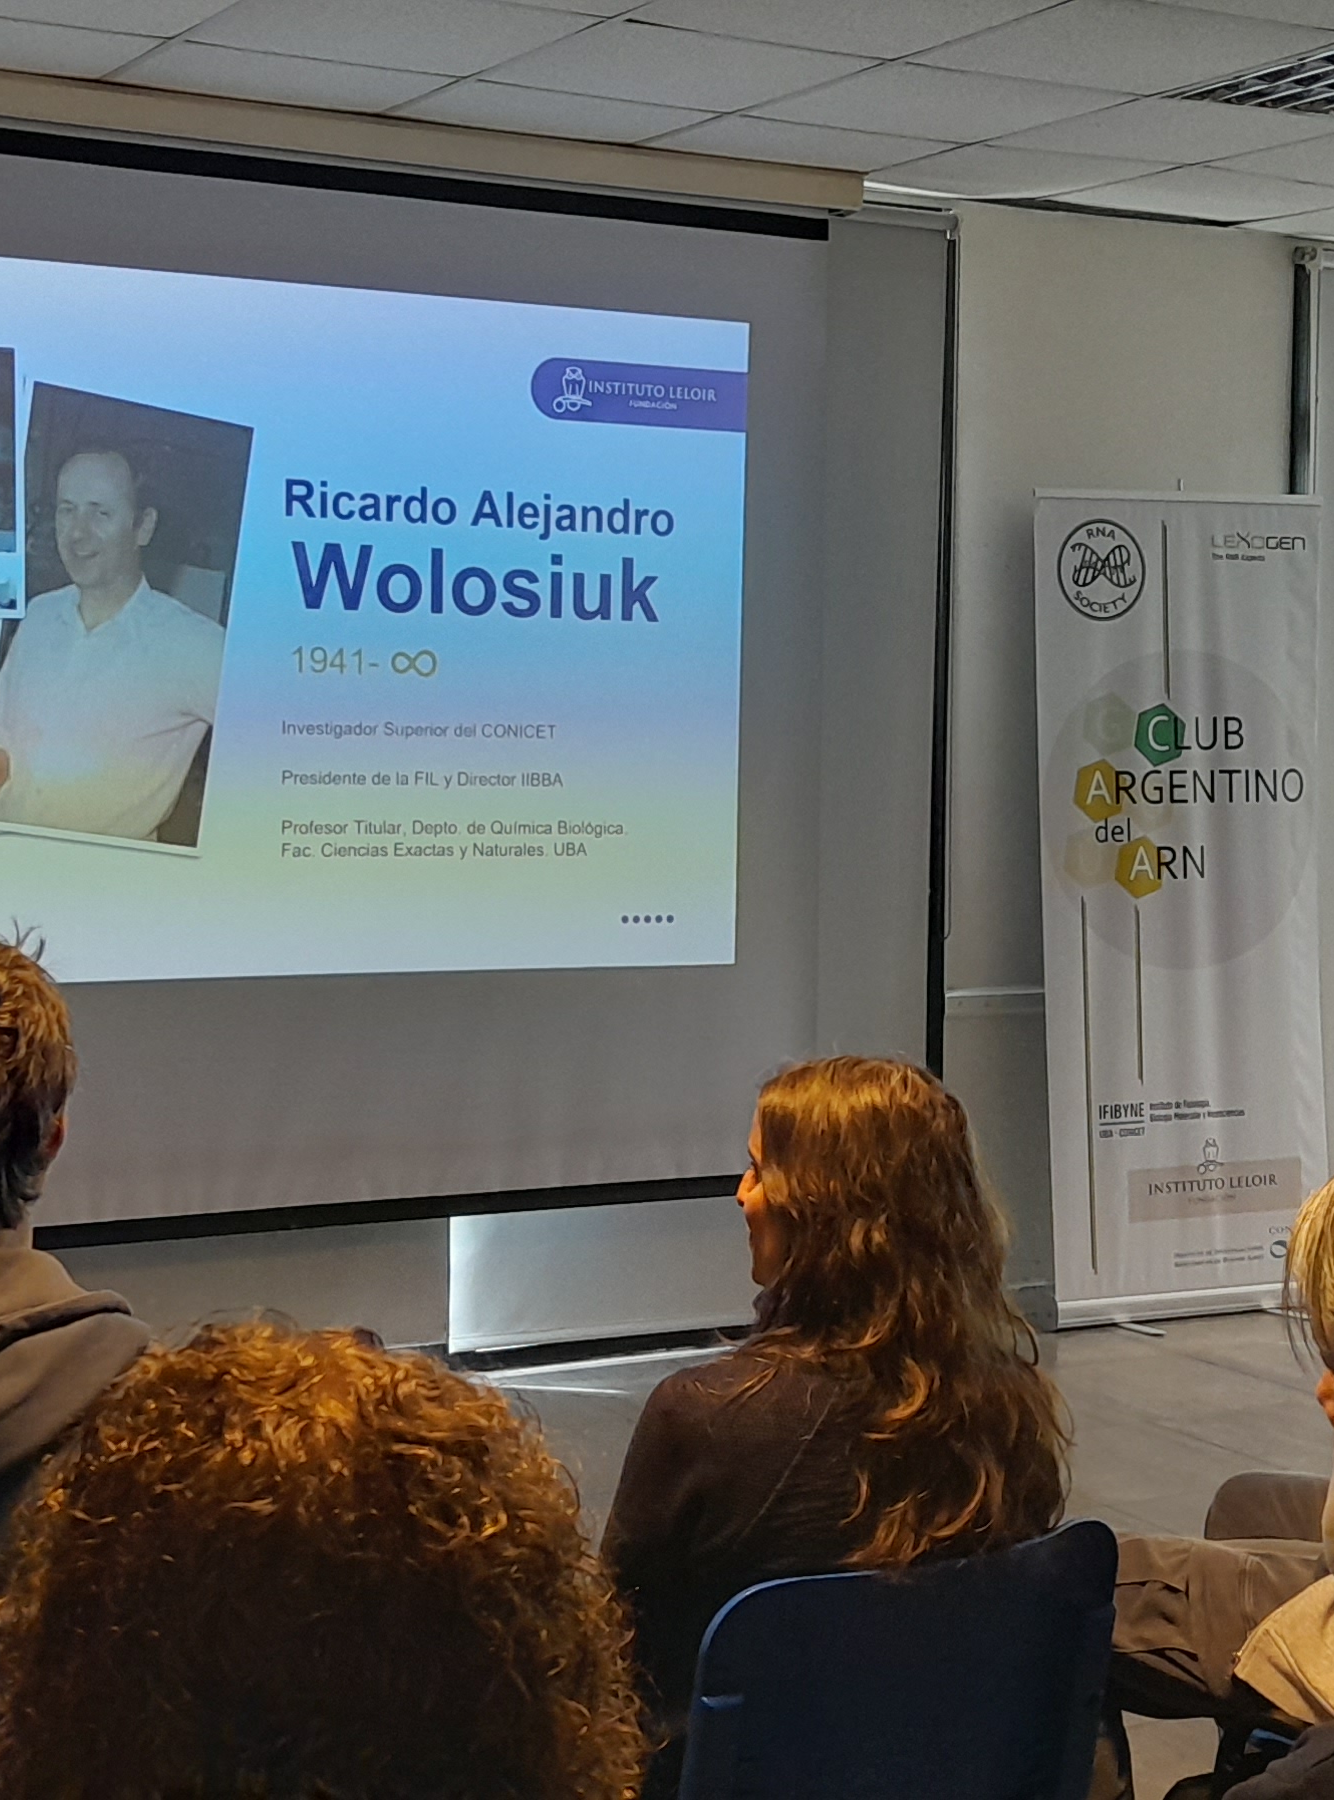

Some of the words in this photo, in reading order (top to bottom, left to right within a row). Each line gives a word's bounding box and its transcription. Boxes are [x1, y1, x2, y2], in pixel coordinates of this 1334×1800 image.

[589, 380, 665, 398] INSTITUTO
[669, 387, 717, 402] LELOIR
[284, 478, 457, 525] Ricardo
[471, 489, 674, 540] Alejandro
[1086, 526, 1116, 541] RNA
[1211, 531, 1306, 551] LEXOGEN
[291, 540, 660, 622] Wolosiuk
[1073, 590, 1128, 614] SOCIETY
[281, 720, 379, 739] Investigador
[383, 721, 450, 739] Superior
[454, 723, 477, 738] del
[481, 723, 556, 739] CONICET
[1148, 715, 1244, 752] CLUB
[281, 770, 367, 786] Presidente
[371, 771, 391, 786] de
[396, 771, 409, 786] la
[414, 771, 439, 786] FIL
[443, 774, 453, 790] y
[457, 771, 516, 787] Director
[521, 772, 564, 788] IIBBA
[1085, 767, 1305, 806] ARGENTINO
[281, 819, 349, 835] Profesor
[353, 820, 407, 837] Titular,
[412, 820, 461, 838] Depto.
[467, 821, 486, 835] de
[490, 820, 552, 836] Química
[1095, 817, 1132, 844] del
[281, 842, 315, 857] Fac.
[321, 842, 389, 858] Ciencias
[393, 842, 454, 857] Exactas
[459, 845, 468, 860] y
[554, 842, 587, 857] UBA
[1129, 844, 1205, 882] ARN
[1099, 1102, 1145, 1120] IFIBYNE
[1148, 1177, 1225, 1196] INSTITUTO
[1229, 1173, 1278, 1189] LELOIR
